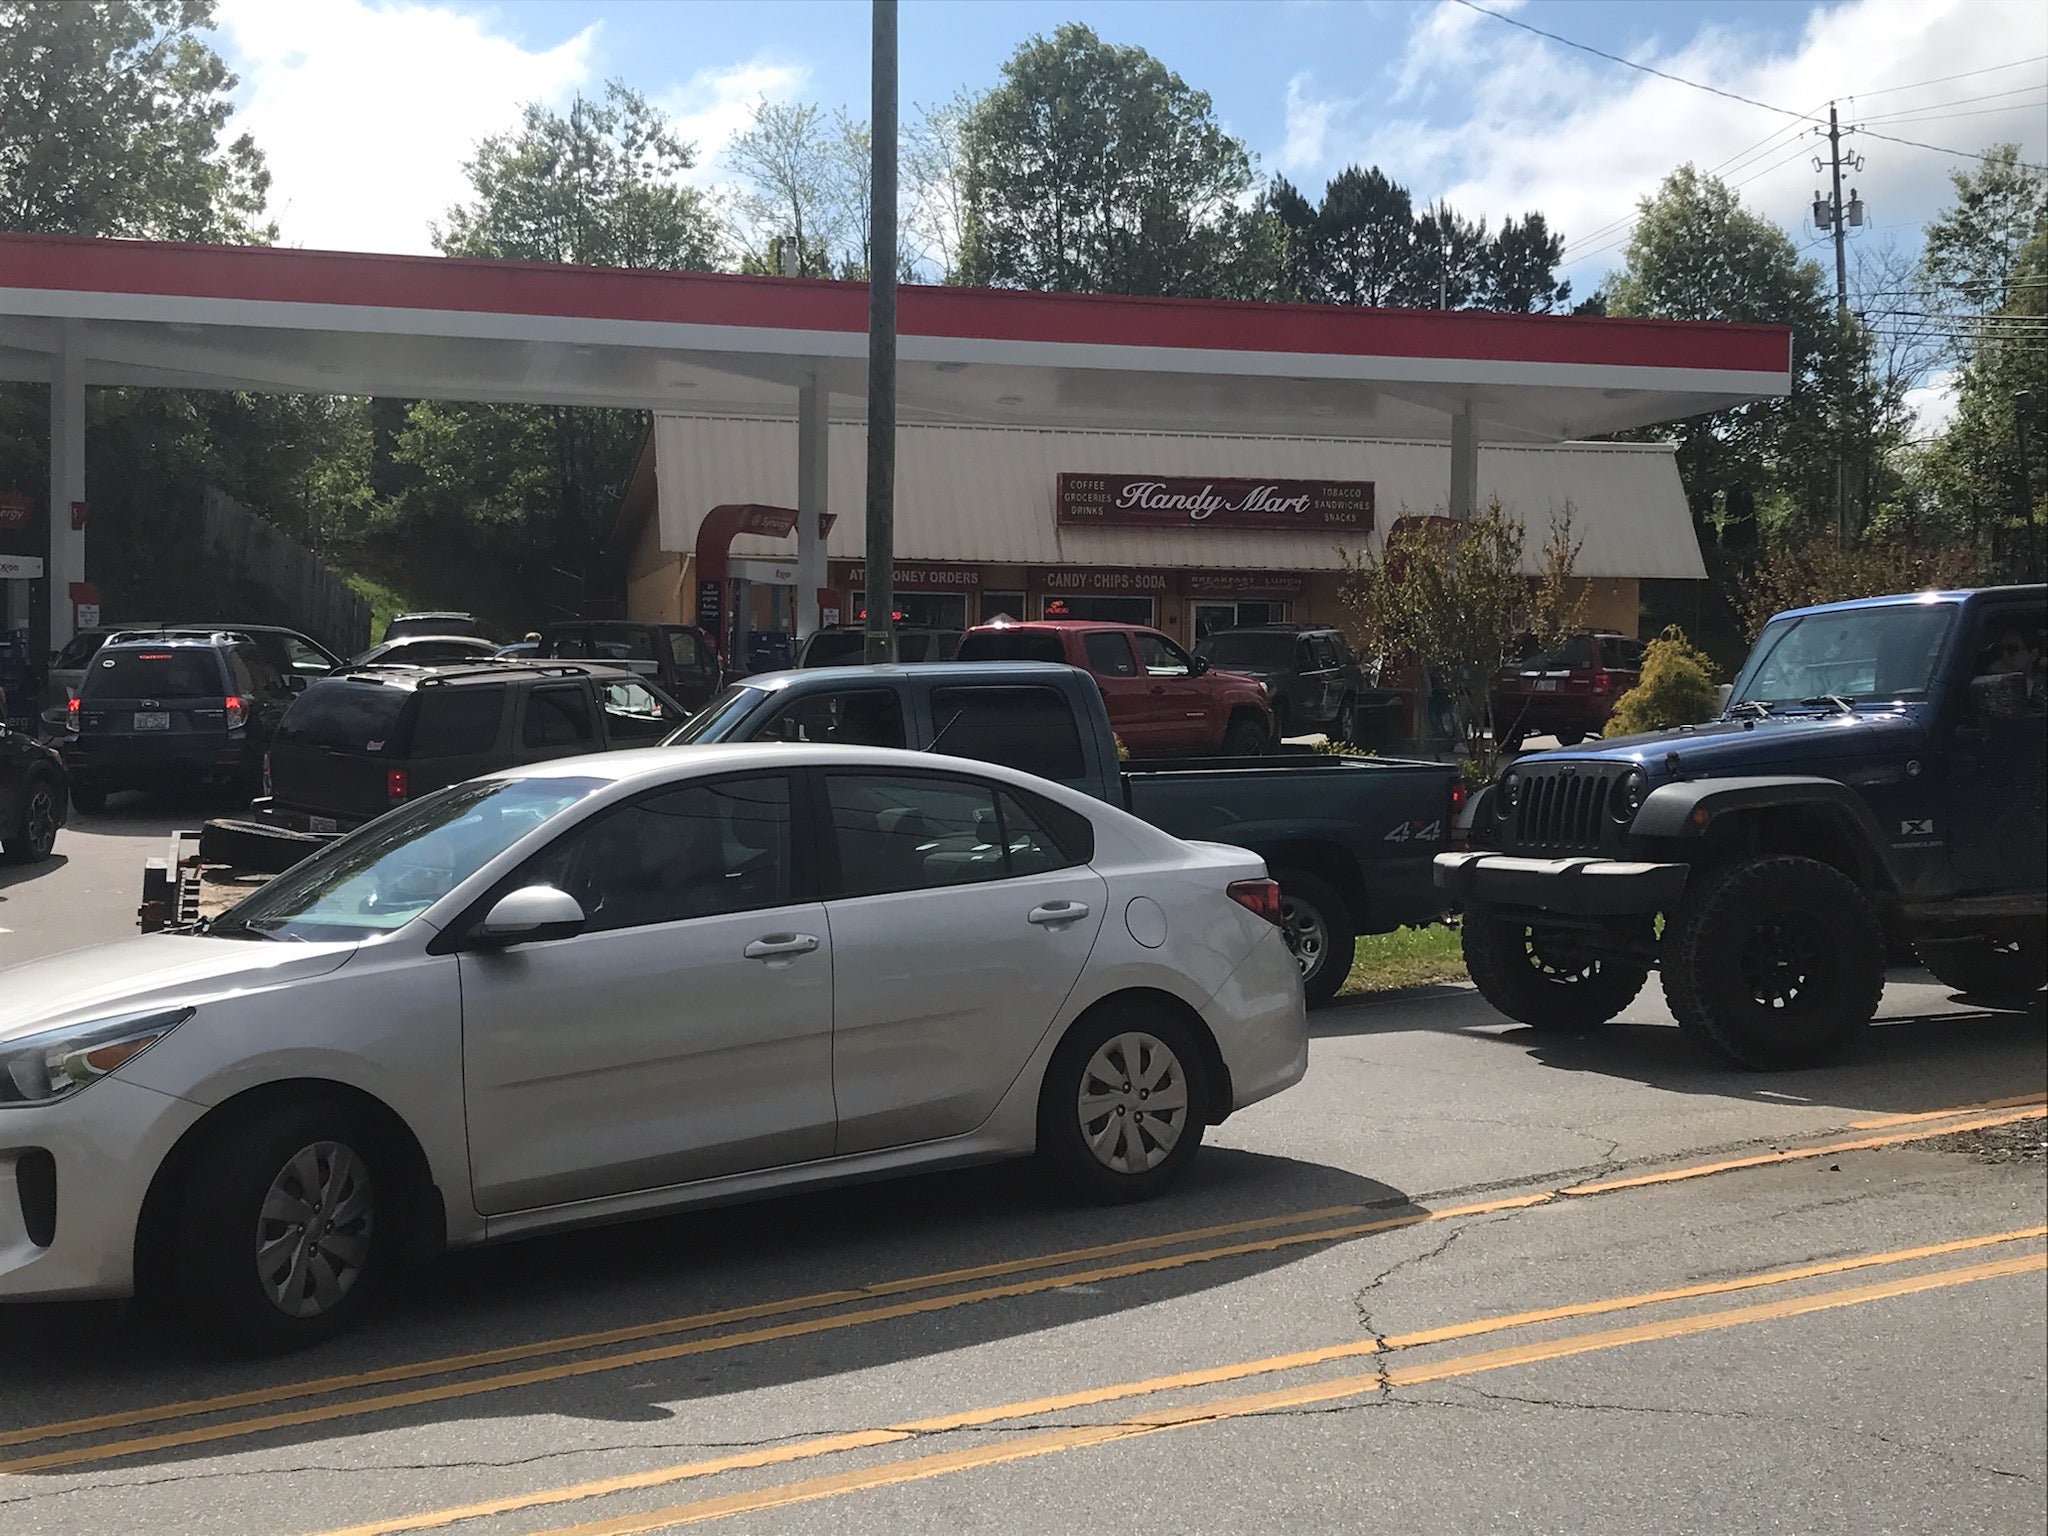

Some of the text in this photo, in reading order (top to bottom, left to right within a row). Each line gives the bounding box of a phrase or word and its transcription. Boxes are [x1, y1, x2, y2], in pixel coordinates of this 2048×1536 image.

[1071, 480, 1105, 490] COFFEE
[1064, 492, 1112, 503] GROCERIES
[1322, 487, 1361, 498] TOBACCO
[1116, 482, 1311, 520] Handy Mart
[1314, 500, 1370, 510] SANDWICHES
[1071, 505, 1104, 516] DRINKS
[1324, 512, 1356, 522] SNACKS
[850, 569, 979, 584] AT ONEY ORDERS
[1047, 572, 1166, 589] CANDY CHIPS SODA
